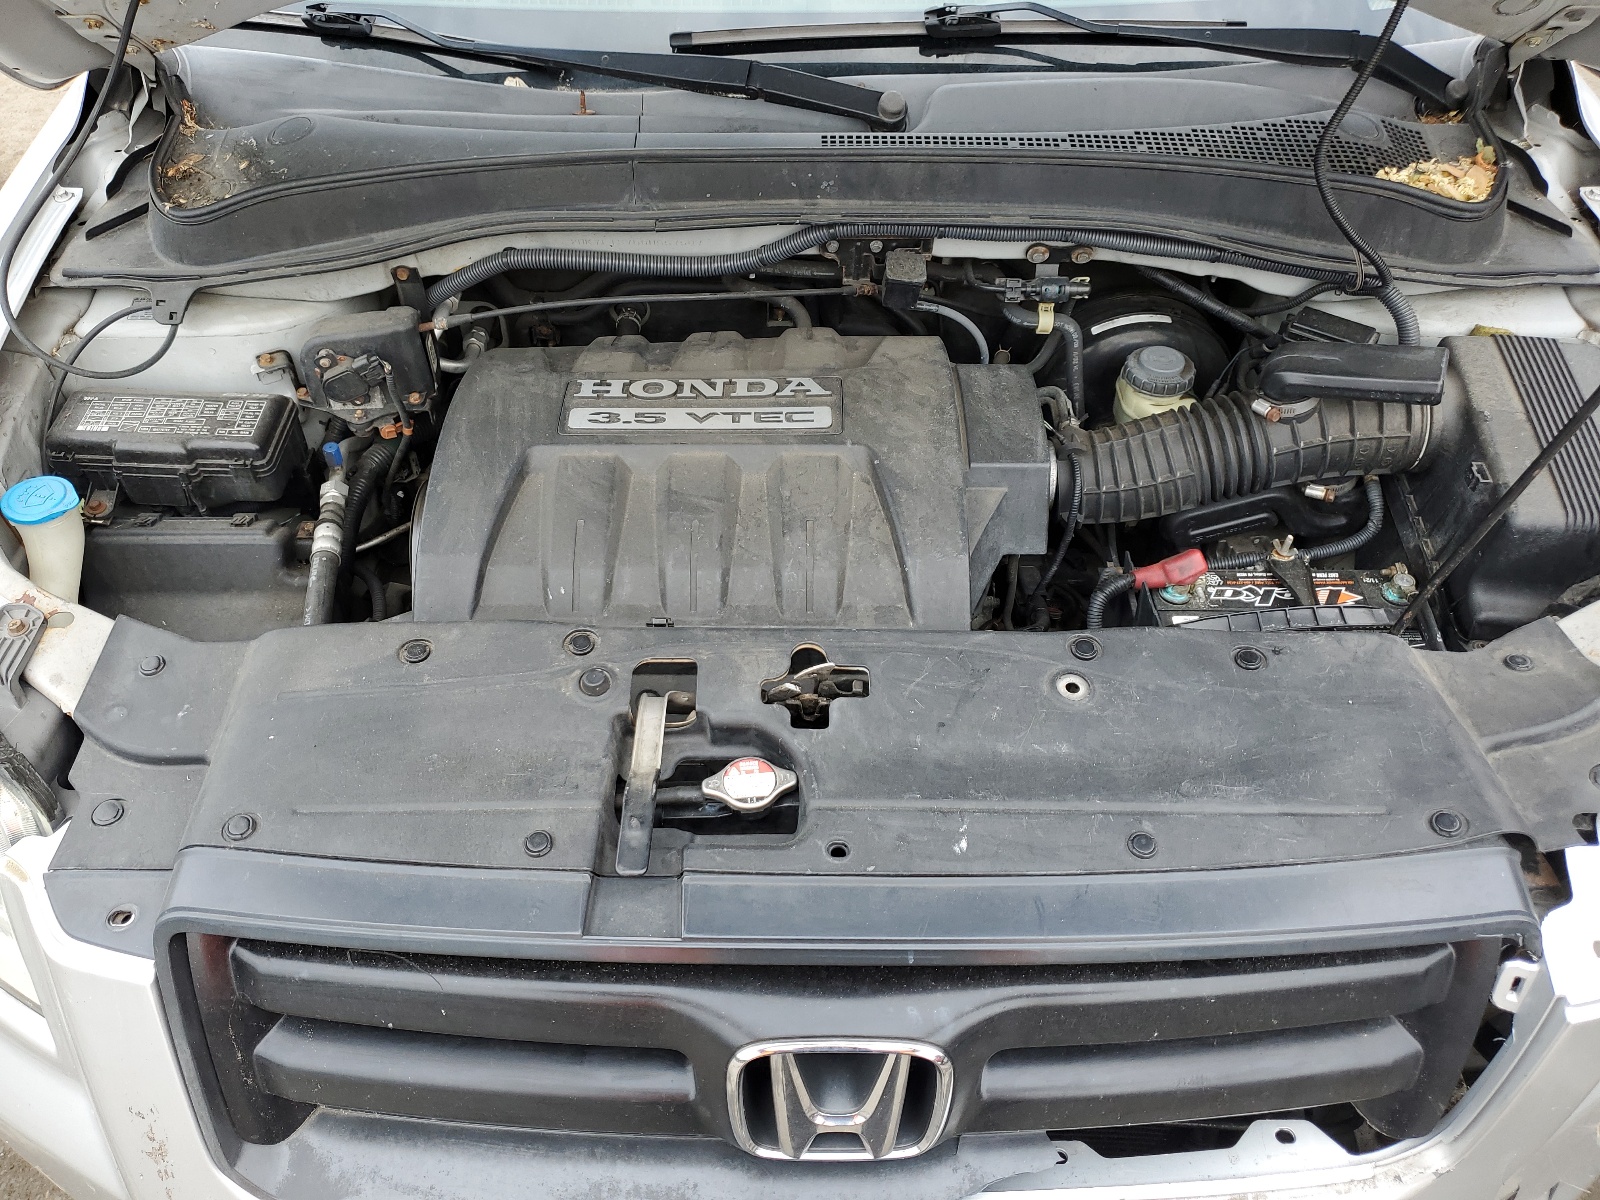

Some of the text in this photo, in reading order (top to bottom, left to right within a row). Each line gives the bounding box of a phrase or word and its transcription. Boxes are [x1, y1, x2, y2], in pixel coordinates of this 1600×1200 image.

[573, 377, 832, 399] HONDA
[587, 410, 815, 424] 3.5 VTEC
